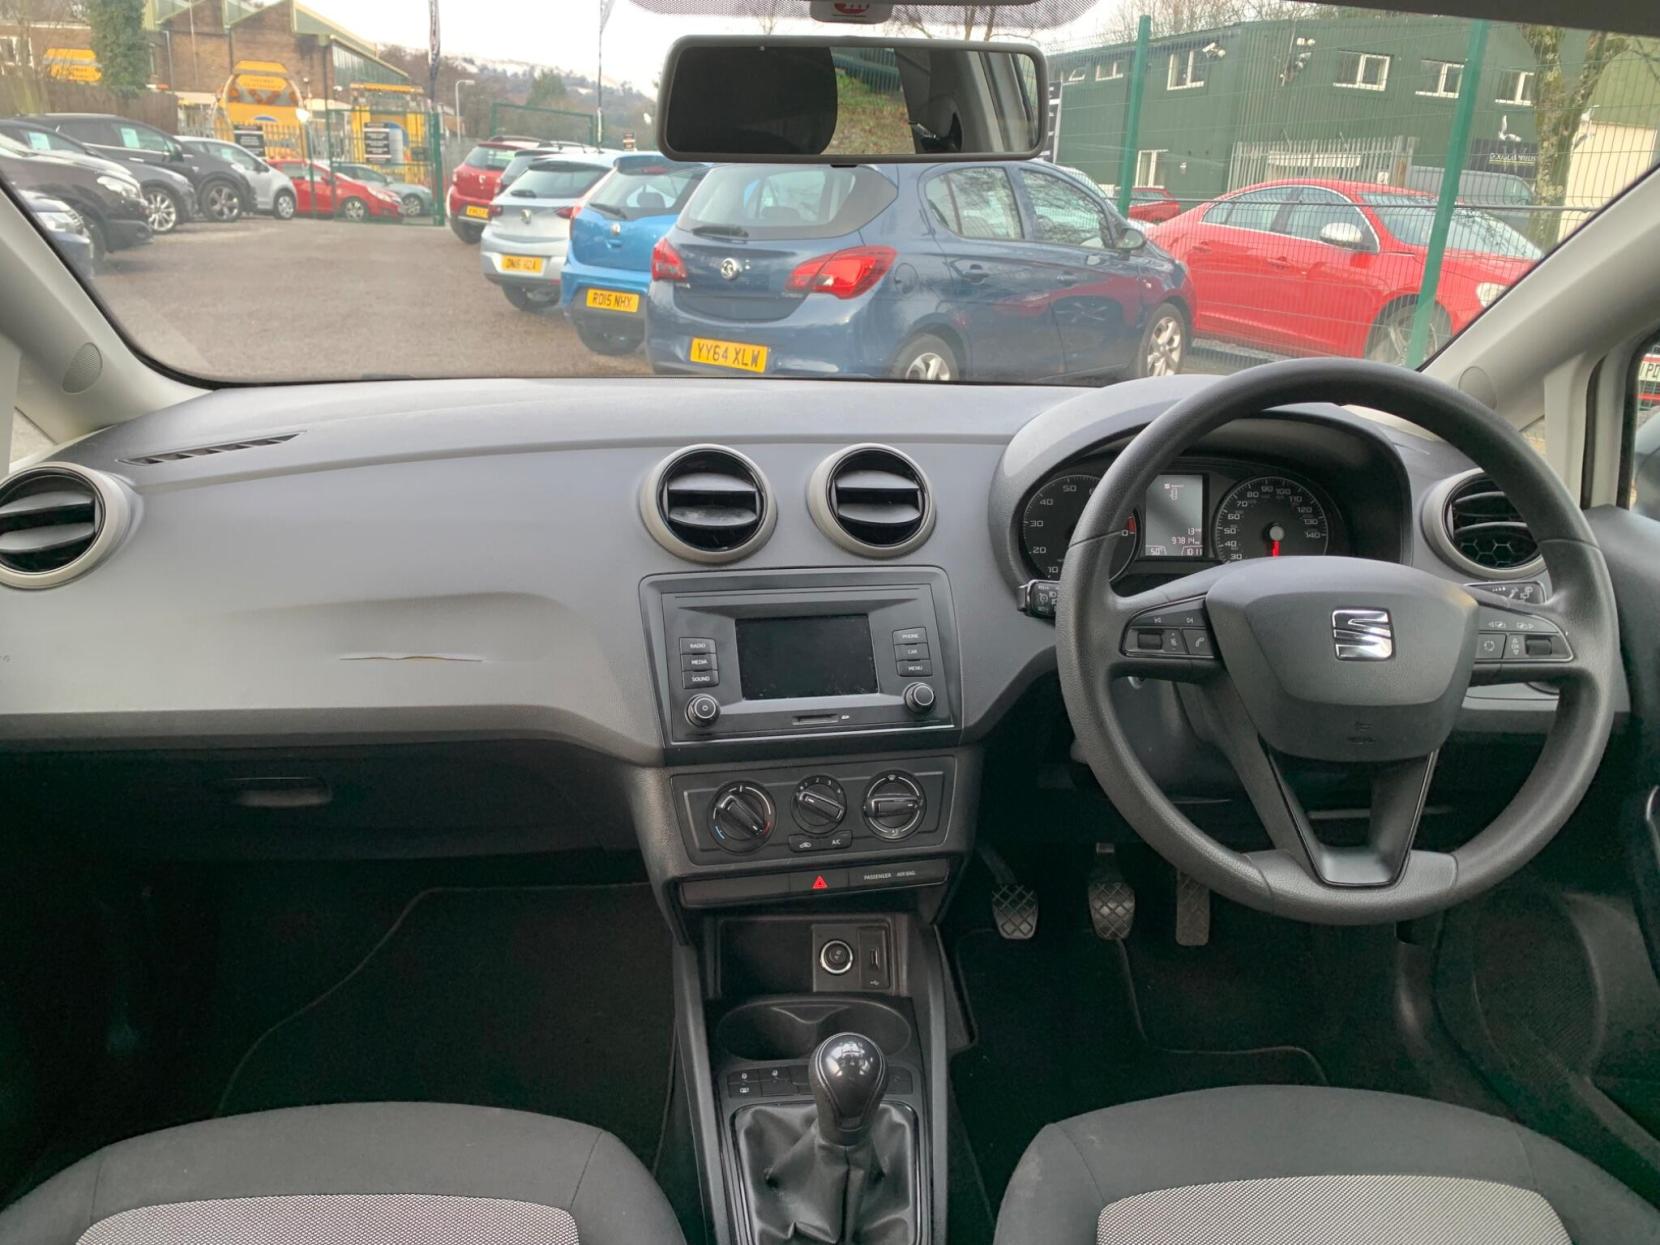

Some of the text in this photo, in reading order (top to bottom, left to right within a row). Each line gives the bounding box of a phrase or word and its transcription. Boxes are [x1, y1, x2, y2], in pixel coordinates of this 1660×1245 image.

[697, 343, 761, 368] YY64 XLW
[1223, 527, 1237, 535] 50
[1224, 540, 1237, 548] 40
[1032, 546, 1047, 554] 20
